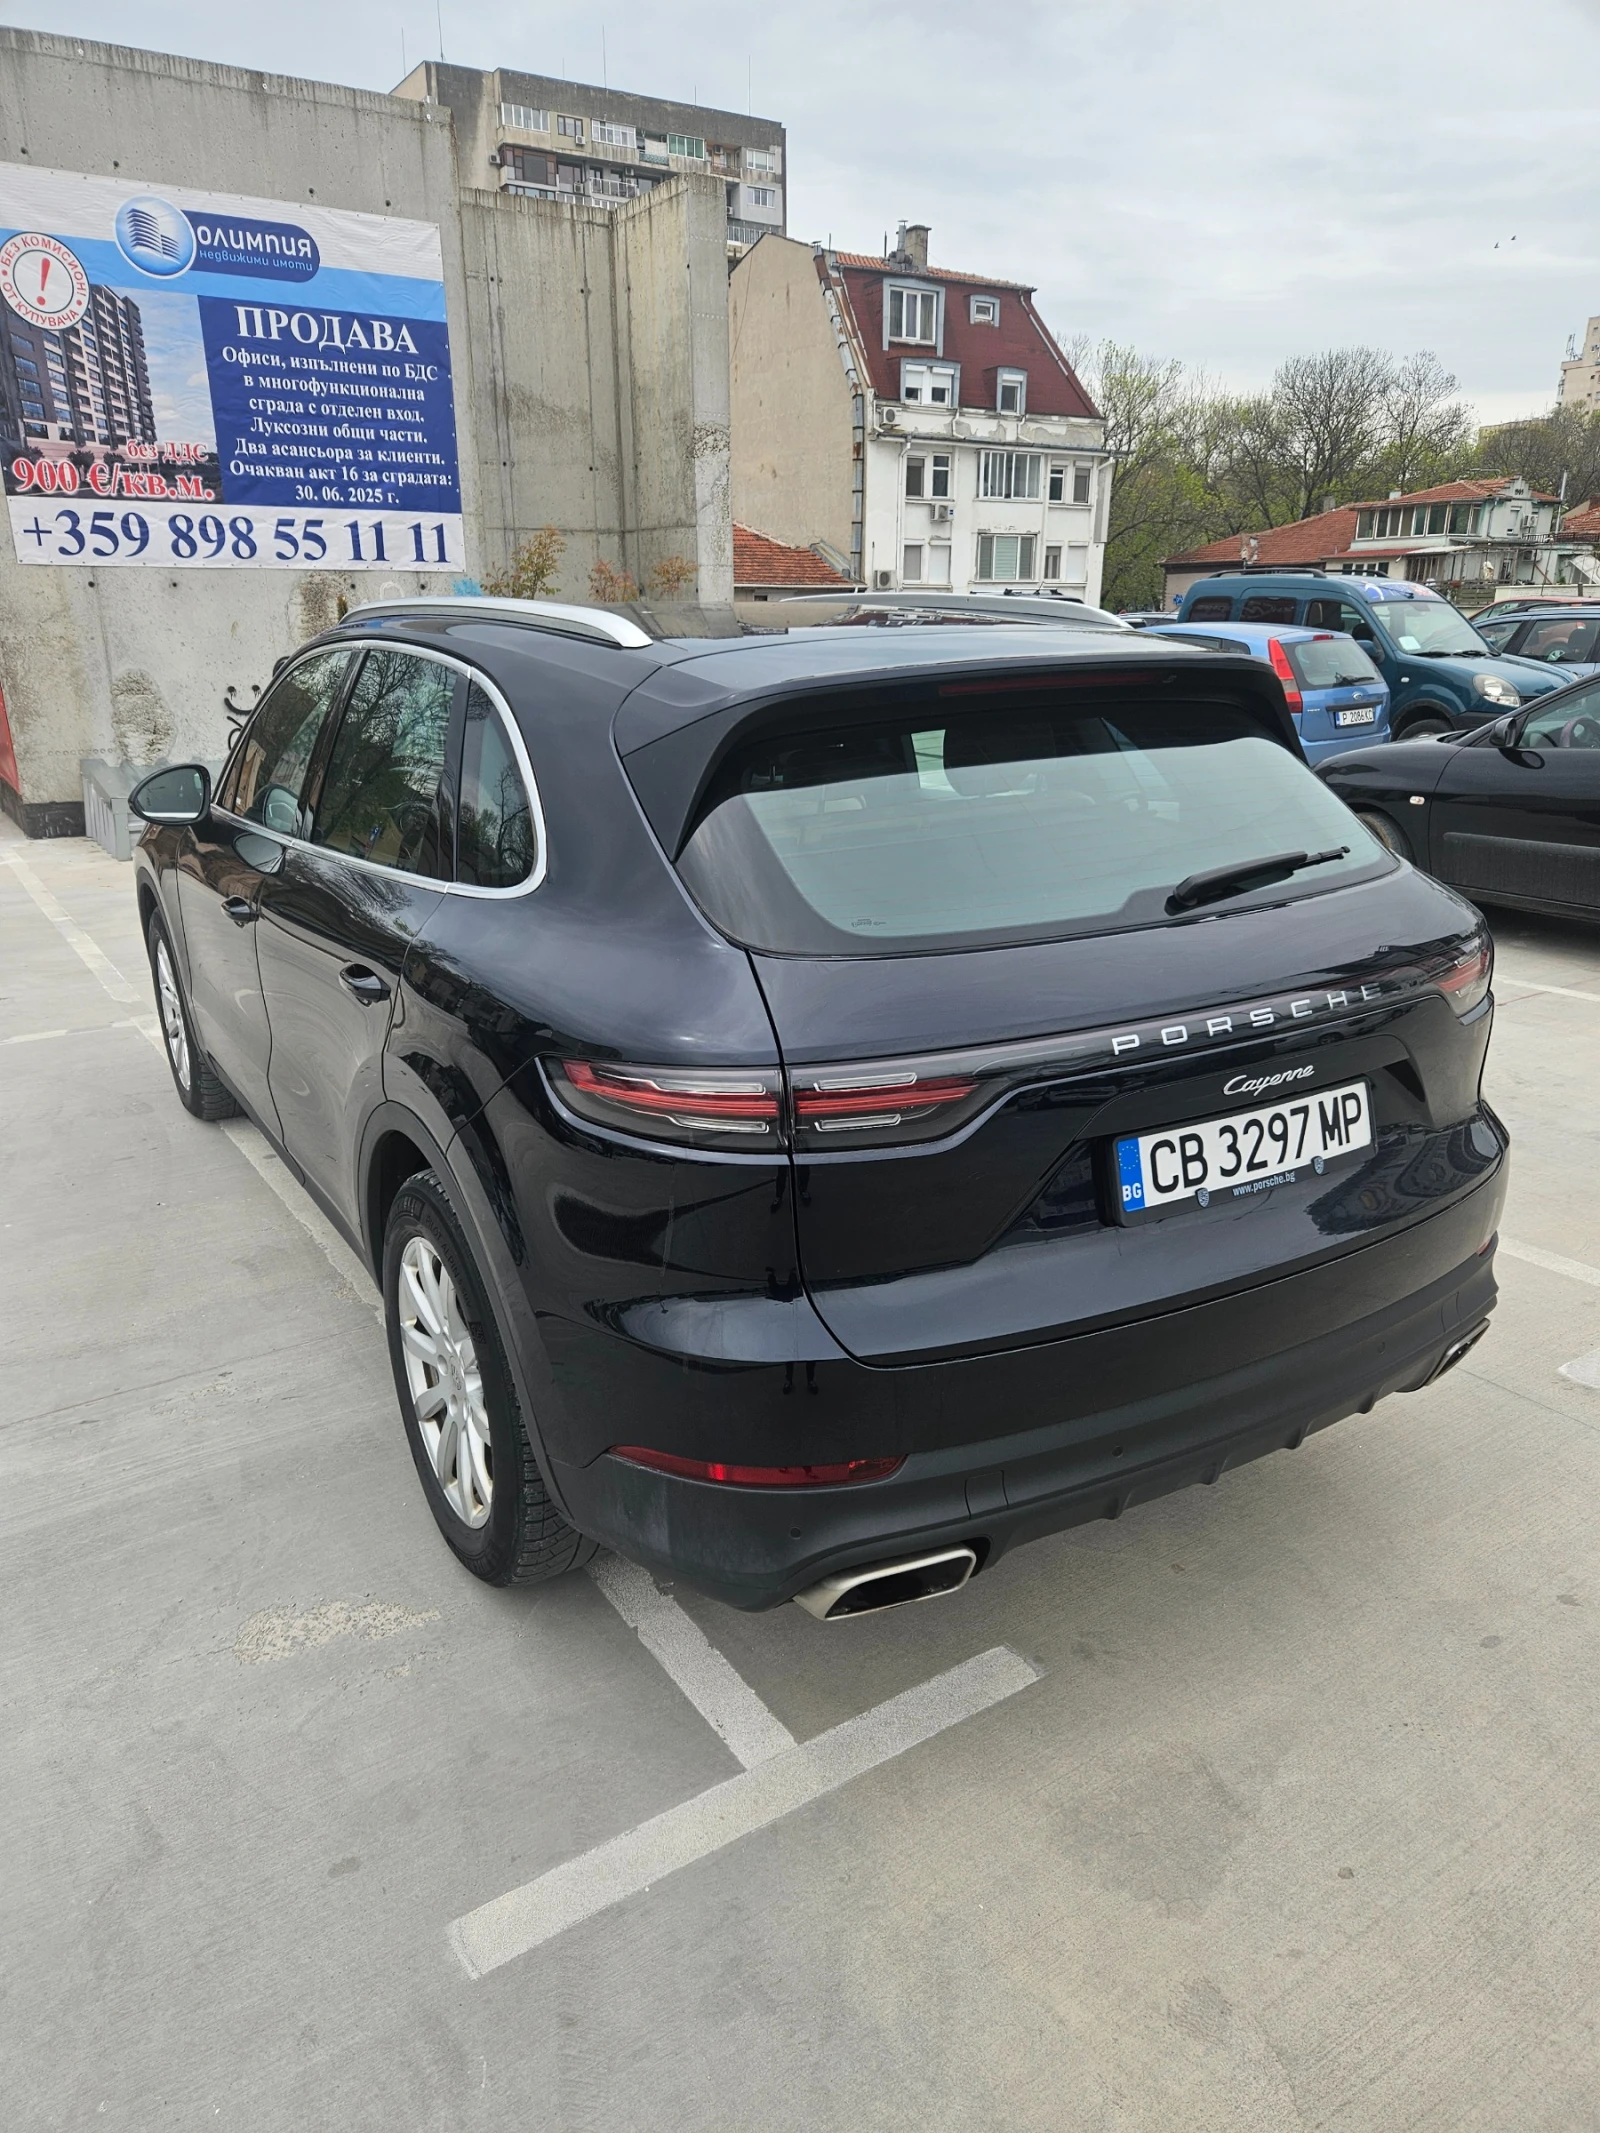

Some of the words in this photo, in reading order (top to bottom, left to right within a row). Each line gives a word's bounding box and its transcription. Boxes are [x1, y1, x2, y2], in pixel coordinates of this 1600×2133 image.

[1, 243, 20, 267] БЕЗ
[21, 237, 87, 298] КОМИСИОН!
[200, 250, 269, 266] недвижими
[272, 259, 313, 272] имоти
[3, 282, 18, 301] ОТ
[15, 301, 80, 327] КУПУВАЧА
[234, 305, 419, 355] ПРОДАВА
[222, 346, 287, 370] Офиси,
[290, 356, 378, 376] изпълнени
[382, 364, 401, 378] по
[405, 364, 438, 382] БДС
[244, 375, 253, 387] в
[259, 375, 425, 402] многофункционална
[249, 398, 304, 415] сграда
[308, 402, 317, 412] с
[321, 404, 383, 419] отделен
[387, 409, 426, 423] вход.
[250, 417, 329, 437] Луксозни
[333, 423, 376, 442] общи
[380, 429, 428, 444] части.
[127, 439, 158, 459] без
[162, 442, 209, 463] ДДС
[235, 438, 267, 456] Два
[271, 443, 353, 462] асансьора
[357, 448, 373, 461] за
[377, 450, 446, 466] клиенти.
[12, 457, 78, 493] 900
[230, 460, 304, 479] Очакван
[309, 466, 337, 481] акт
[341, 466, 359, 482] 16
[362, 469, 378, 483] за
[382, 470, 453, 487] сградата:
[349, 487, 383, 503] 2025
[387, 491, 400, 504] г.
[23, 509, 150, 557] +359
[168, 513, 258, 560] 898
[273, 518, 327, 561] 55
[343, 520, 390, 562] 11
[407, 522, 451, 563] 11
[1111, 982, 1382, 1056] PORSCHE
[1222, 1064, 1315, 1096] Cayenne
[1150, 1132, 1209, 1195] CB
[1218, 1105, 1310, 1178] 3297
[1318, 1091, 1362, 1152] MP
[1122, 1182, 1142, 1202] BG
[1232, 1170, 1296, 1197] www.porsche.bg
[441, 1244, 459, 1278] ALPIN
